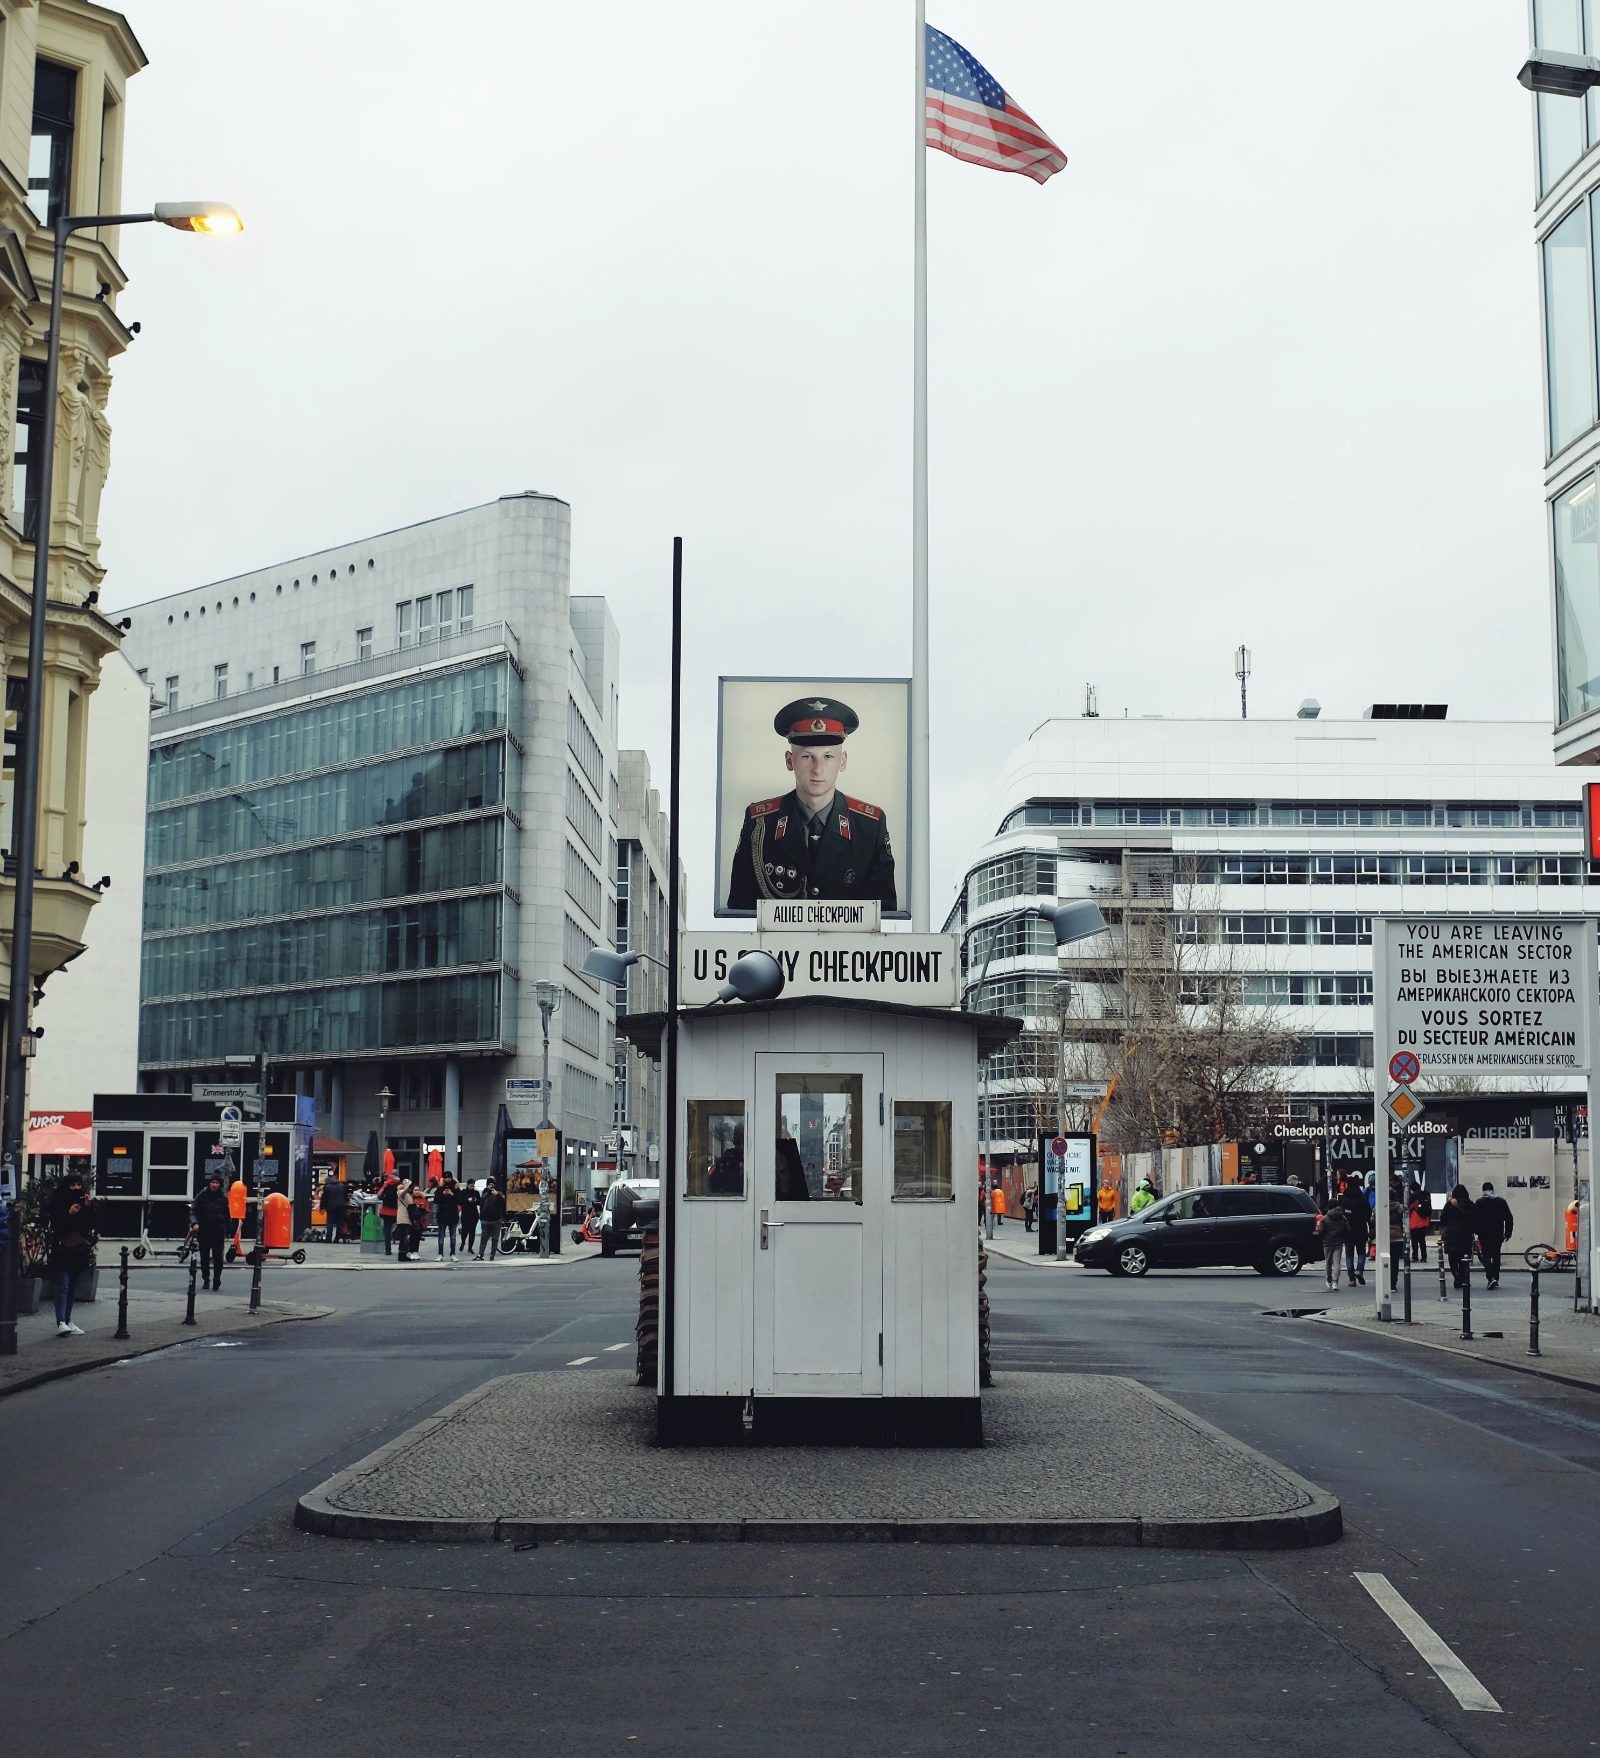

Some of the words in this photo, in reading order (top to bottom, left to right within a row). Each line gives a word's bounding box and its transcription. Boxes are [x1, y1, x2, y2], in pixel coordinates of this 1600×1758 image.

[773, 905, 804, 923] ALLIED
[807, 905, 865, 924] CHECKPOINT
[1407, 925, 1440, 940] YOU
[1451, 925, 1483, 940] ARE
[1494, 925, 1563, 941] LEAVING
[1398, 944, 1424, 959] THE
[1432, 944, 1508, 960] AMERICAN
[1518, 944, 1572, 960] SECTOR
[809, 950, 943, 983] CHECKPOINT
[1401, 968, 1426, 984] ВЫ
[1436, 968, 1538, 985] ВЫЕЗЖАЕТЕ
[1549, 968, 1570, 985] ИЗ
[1397, 987, 1511, 1003] АМЕРИКАНСКОГО
[1516, 987, 1576, 1004] СЕКТОРА
[1421, 1009, 1469, 1026] VOUS
[1478, 1009, 1543, 1027] SORTEZ
[1398, 1029, 1417, 1046] DU
[1423, 1029, 1489, 1046] SECTEUR
[1494, 1028, 1576, 1047] AMÉRICAIN
[1416, 1053, 1458, 1065] ERLASSEN
[1458, 1053, 1474, 1065] DEN
[1476, 1053, 1544, 1066] AMERIKANISCHEN
[1546, 1054, 1576, 1066] SEKTOR
